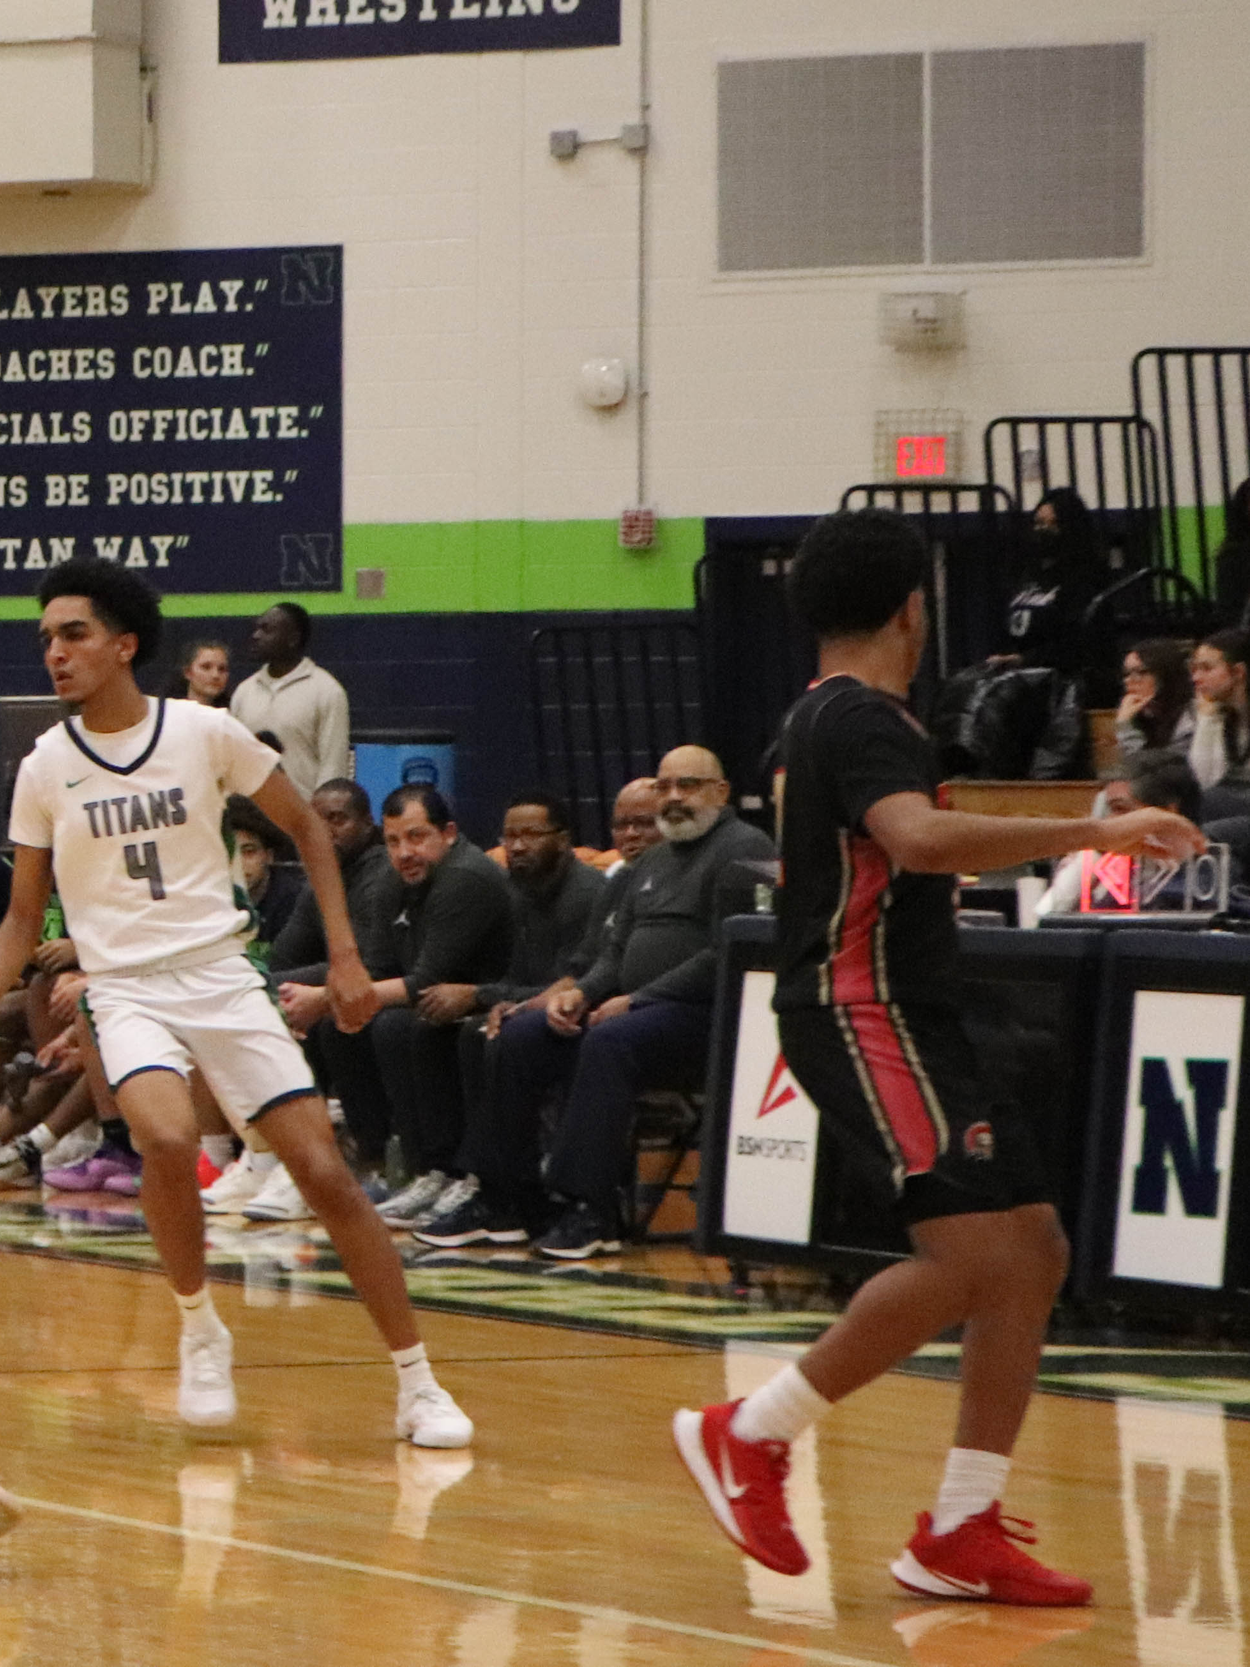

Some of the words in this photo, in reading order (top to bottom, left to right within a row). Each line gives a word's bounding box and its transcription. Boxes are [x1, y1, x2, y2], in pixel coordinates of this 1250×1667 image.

[896, 436, 947, 477] EXIT
[45, 474, 90, 506] BE
[83, 787, 187, 838] TITANS
[123, 841, 166, 900] 4
[1131, 1056, 1231, 1219] N
